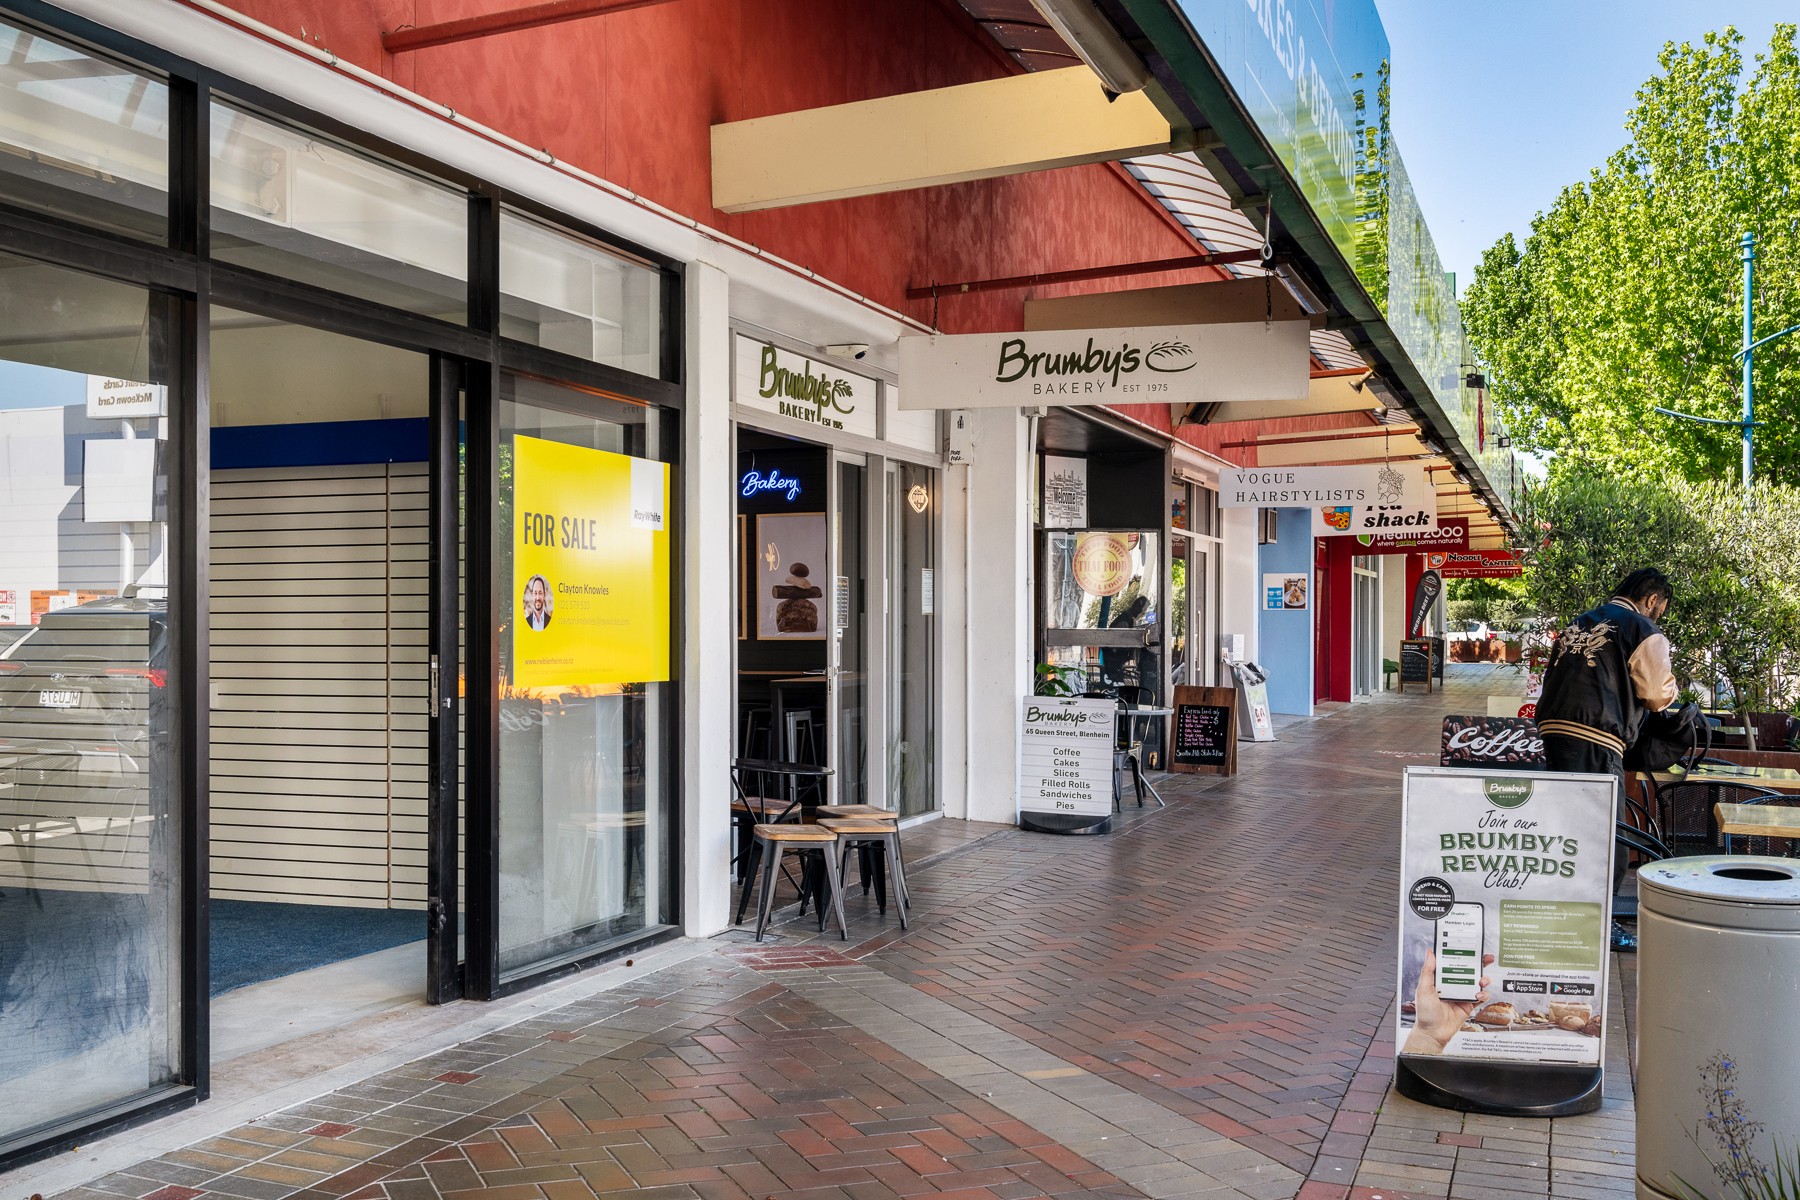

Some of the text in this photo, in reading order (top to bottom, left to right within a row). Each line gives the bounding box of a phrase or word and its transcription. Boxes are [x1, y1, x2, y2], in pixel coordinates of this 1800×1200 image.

[1246, 0, 1295, 80] KES
[1298, 36, 1307, 107] &
[1310, 57, 1356, 195] BEYOND
[996, 337, 1141, 387] Brumby's
[758, 345, 832, 422] Brumby's
[1033, 381, 1168, 395] BAKERY EST 1975
[779, 401, 816, 423] BAKERY
[822, 417, 832, 427] EST
[741, 470, 801, 501] Bakery
[1236, 473, 1296, 485] VOGUE
[1236, 489, 1366, 502] HAIRSTYLISTS
[1363, 511, 1431, 528] shack
[524, 511, 597, 551] FOR SALE
[1078, 559, 1128, 573] THAI FOOD
[558, 582, 609, 596] Clayton Knowles
[1025, 706, 1087, 727] Brumby's
[1034, 728, 1055, 736] Queen
[1056, 729, 1078, 738] Street,
[1079, 731, 1110, 739] Blenheim
[1449, 727, 1544, 757] Coffee
[1053, 747, 1081, 757] Coffee
[1053, 758, 1080, 767] Cakes
[1053, 768, 1080, 778] Slices
[1041, 778, 1091, 789] Filled Rolls
[1490, 783, 1527, 794] Brumby's
[1040, 789, 1092, 800] Sandwiches
[1056, 801, 1075, 810] Pies
[1478, 809, 1538, 830] Join our
[1439, 832, 1579, 856] BRUMBY'S
[1441, 854, 1576, 878] REWARDS
[1483, 868, 1531, 890] Club!
[1415, 881, 1431, 892] SPEND
[1436, 883, 1449, 893] EARN
